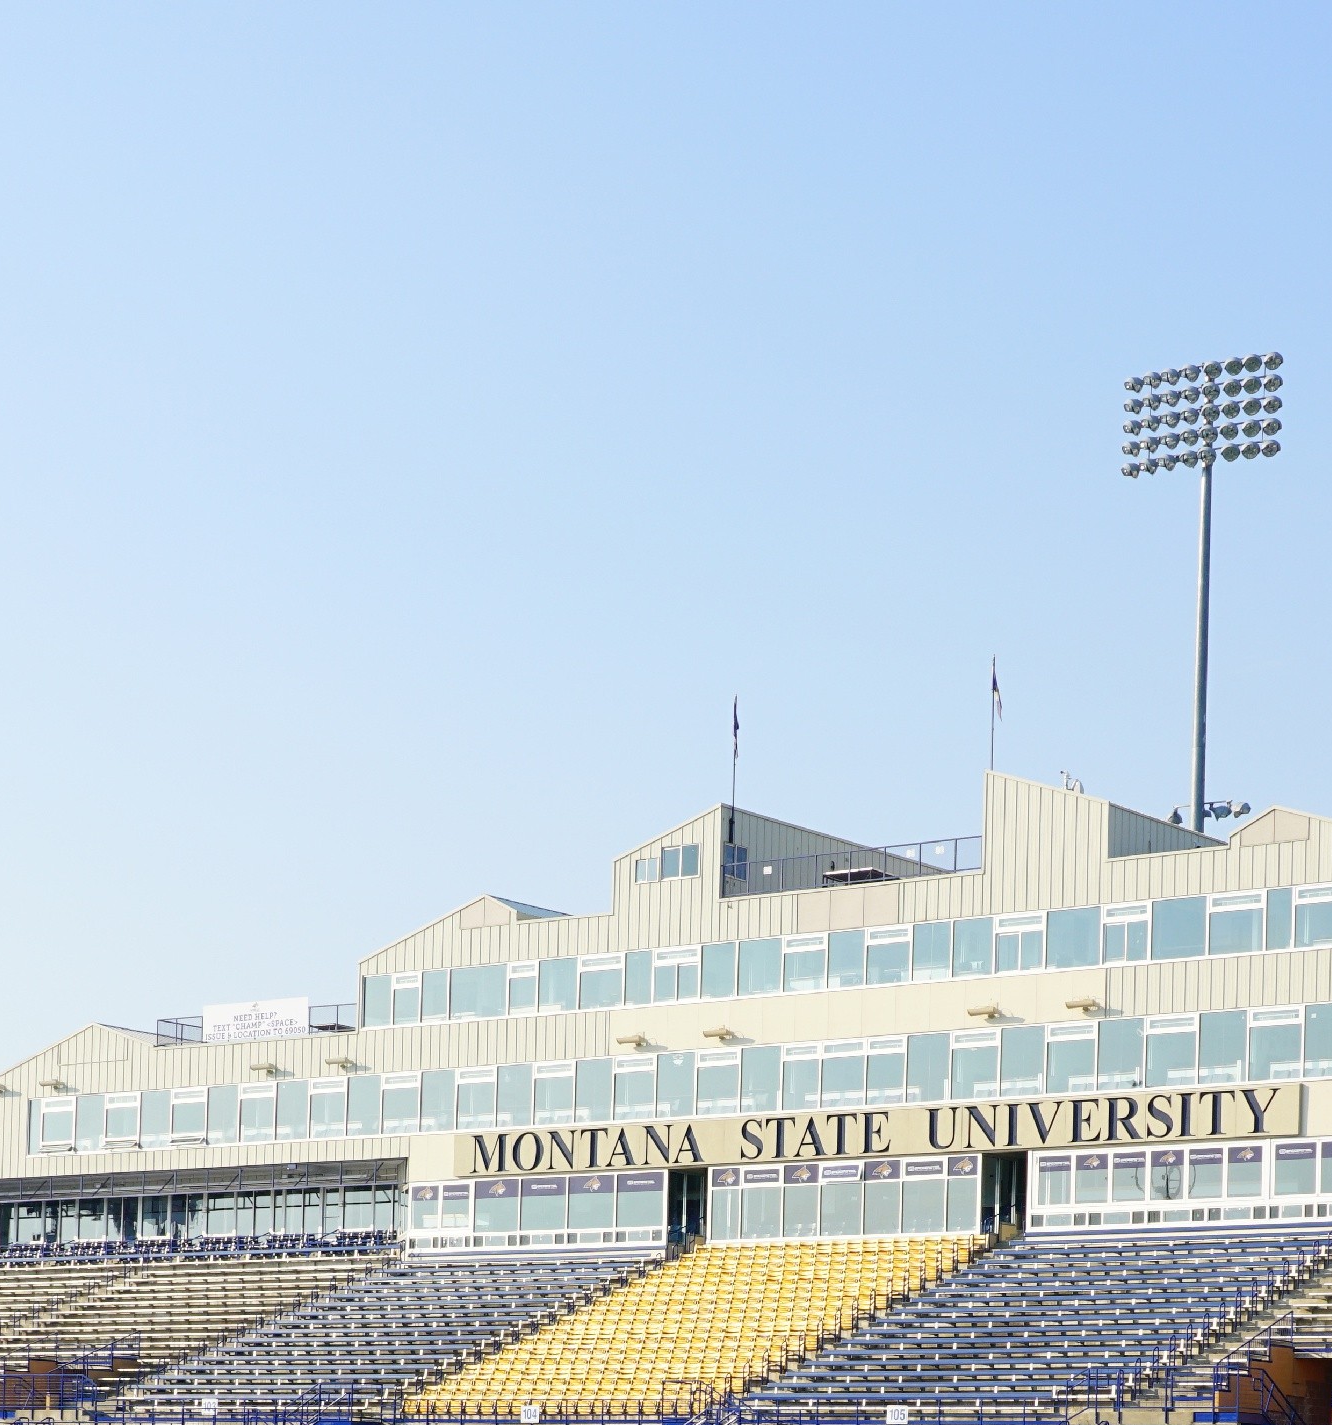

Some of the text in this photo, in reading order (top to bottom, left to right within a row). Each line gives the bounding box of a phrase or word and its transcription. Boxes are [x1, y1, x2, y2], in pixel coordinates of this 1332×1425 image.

[233, 1012, 277, 1022] NEED HELP?
[205, 1033, 225, 1041] ISSUE
[233, 1029, 271, 1039] LOCATION
[274, 1028, 283, 1036] TO
[285, 1026, 306, 1035] 69050
[213, 1024, 230, 1032] TEXT
[471, 1088, 1282, 1173] MONTANA STATE UNIVERSITY
[523, 1409, 537, 1420] 104
[889, 1409, 906, 1420] 105
